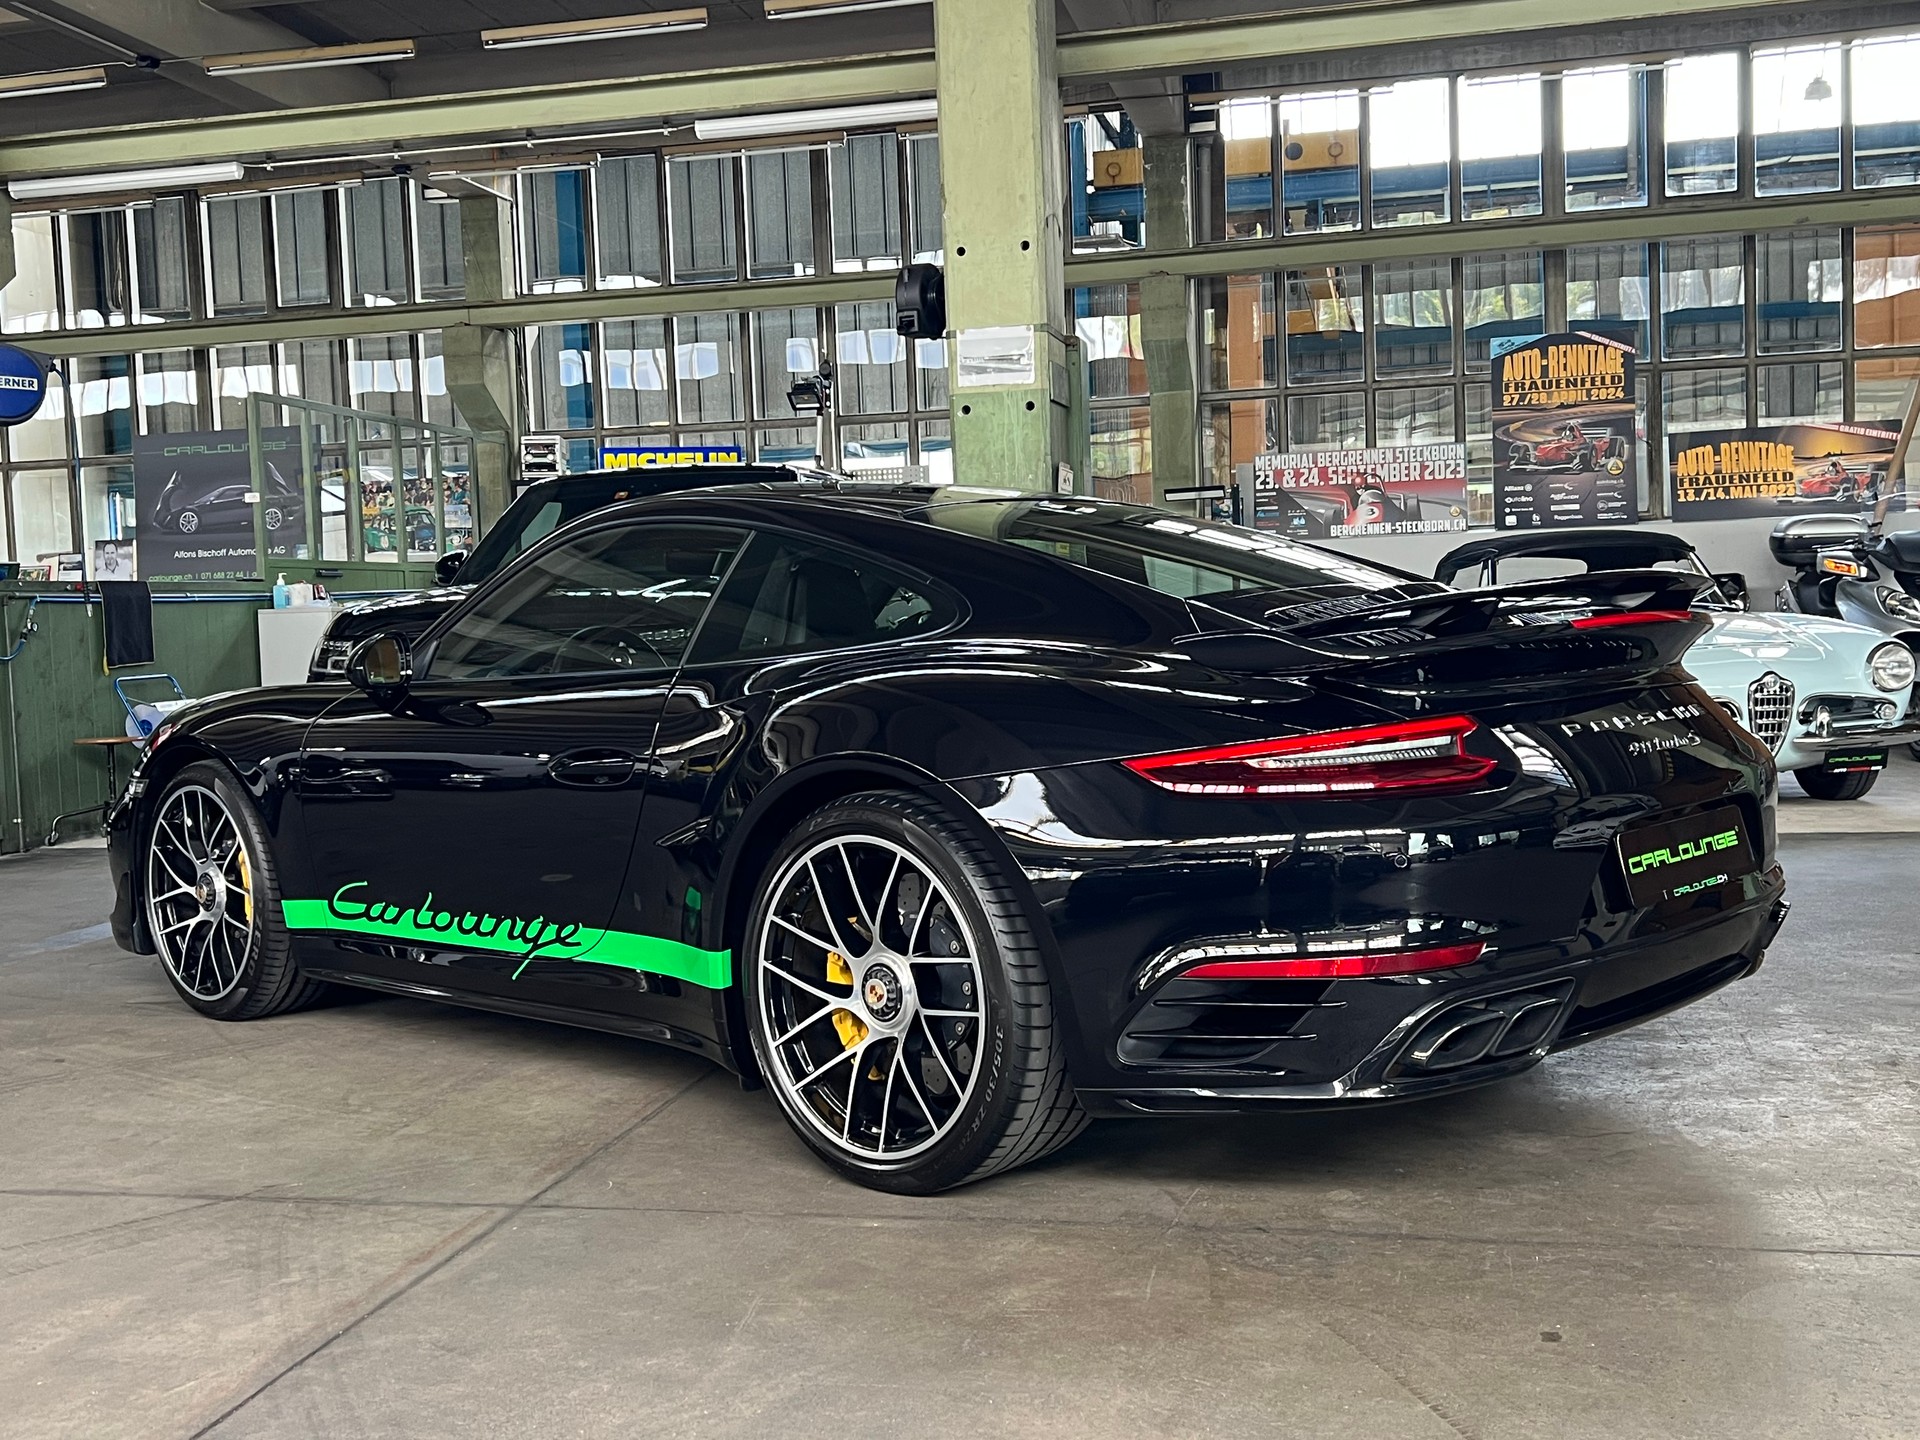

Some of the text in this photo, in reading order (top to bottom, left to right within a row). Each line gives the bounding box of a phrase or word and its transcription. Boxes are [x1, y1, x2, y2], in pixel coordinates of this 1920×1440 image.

[1503, 344, 1624, 381] AUTO-RENNTAGE
[1503, 375, 1623, 393] FRAUENFELD
[1590, 387, 1625, 400] 2024
[164, 441, 286, 456] CARLOUGE
[1255, 443, 1465, 471] MEMORIAL BERGRENNEN STECKBORN
[603, 452, 738, 470] MICHELIN
[1677, 441, 1795, 476] AUTO-RENNTAGE
[1255, 470, 1279, 490] 23.
[1282, 469, 1297, 488] &
[1299, 467, 1325, 487] 24.
[1423, 459, 1465, 479] 2023
[1679, 471, 1794, 488] FRAUENFELD
[1760, 483, 1796, 497] 2023
[1329, 519, 1467, 537] BERGRENNEN-STECKBORN.CH
[174, 550, 196, 559] Alfons
[198, 549, 227, 558] Bischoff
[273, 546, 286, 554] AG
[201, 572, 212, 580] 071
[213, 571, 225, 579] 688
[226, 571, 234, 579] 22
[1628, 830, 1739, 875] CARLOUNGE
